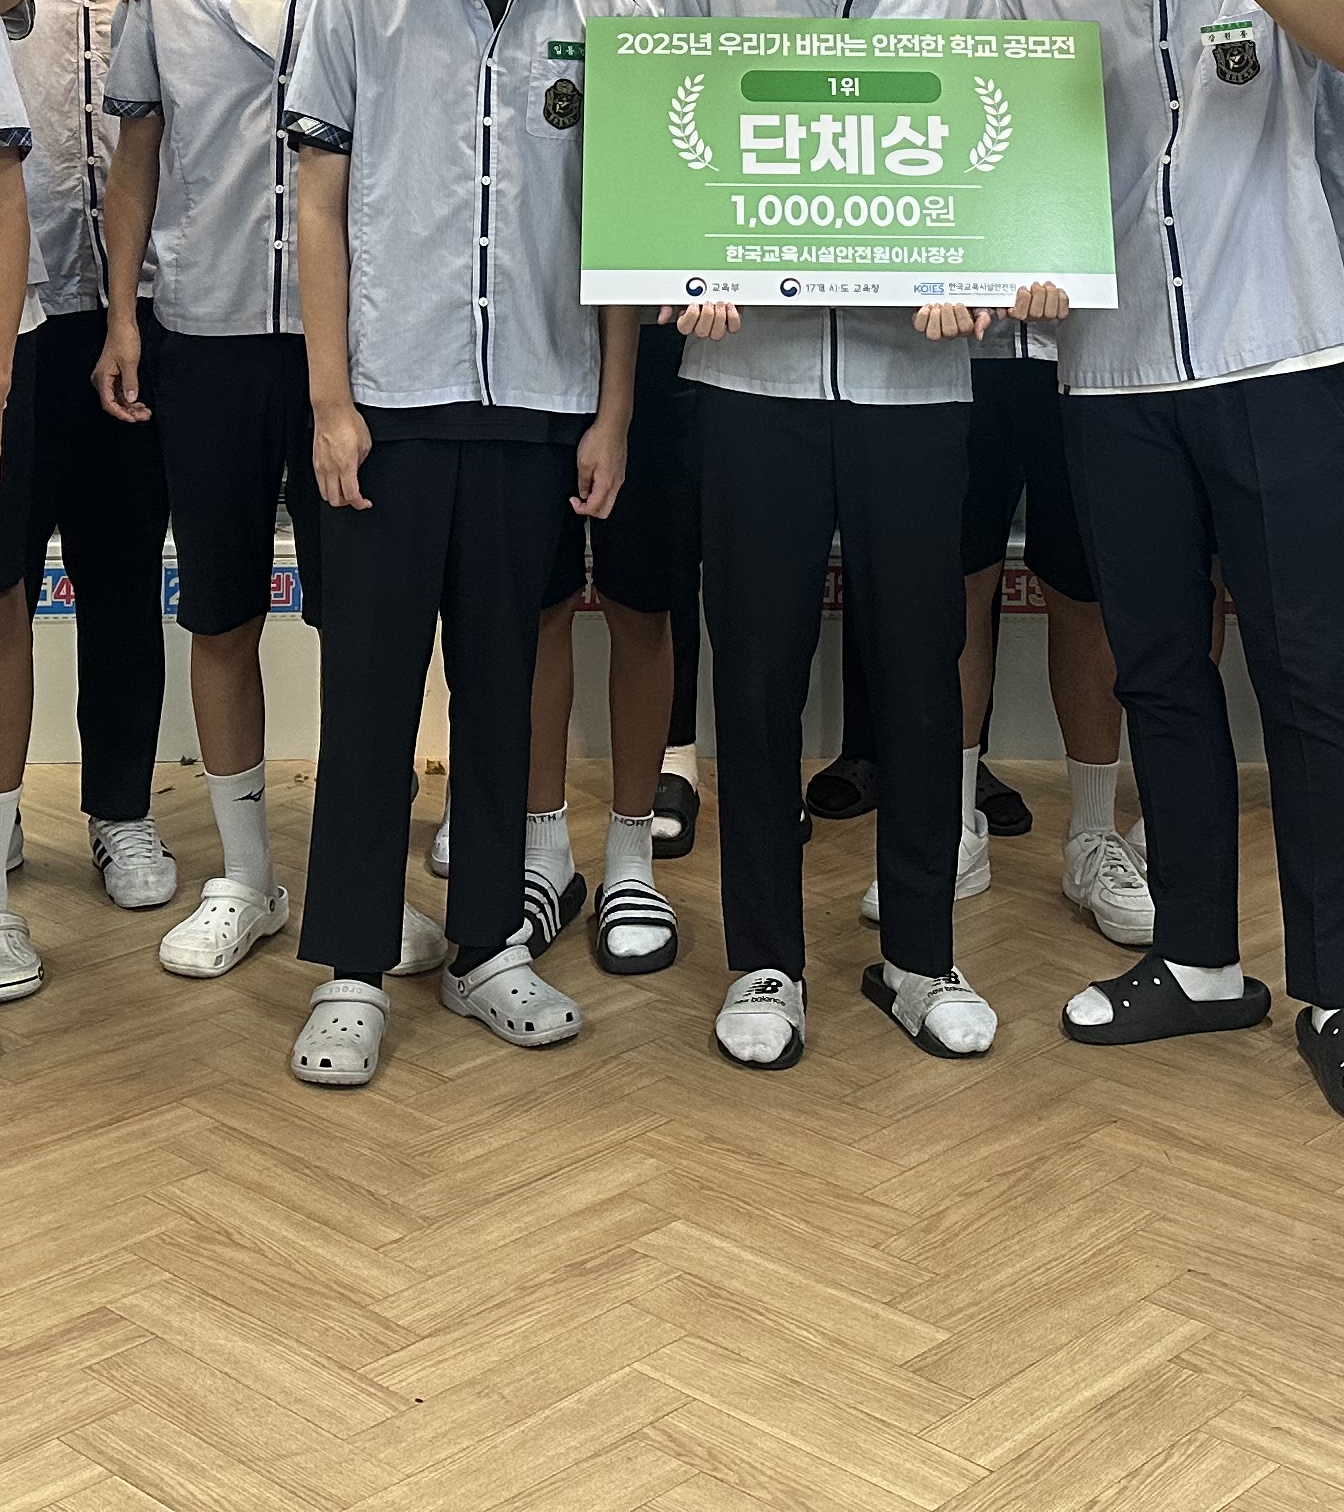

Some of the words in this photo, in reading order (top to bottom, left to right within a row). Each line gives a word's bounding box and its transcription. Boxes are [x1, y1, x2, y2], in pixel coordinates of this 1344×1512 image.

[617, 32, 712, 55] 2025년
[718, 33, 791, 56] 우리가
[796, 33, 867, 57] 바라는
[872, 34, 945, 58] 안전한
[950, 34, 999, 58] 학교
[1003, 35, 1076, 59] 공모전
[827, 77, 860, 97] 1위
[739, 114, 949, 176] 단체상
[730, 194, 956, 229] 1,000,000원
[725, 244, 965, 265] 한국교육시설안전원이사장상
[712, 283, 740, 293] 교육부
[853, 284, 880, 293] 교육청
